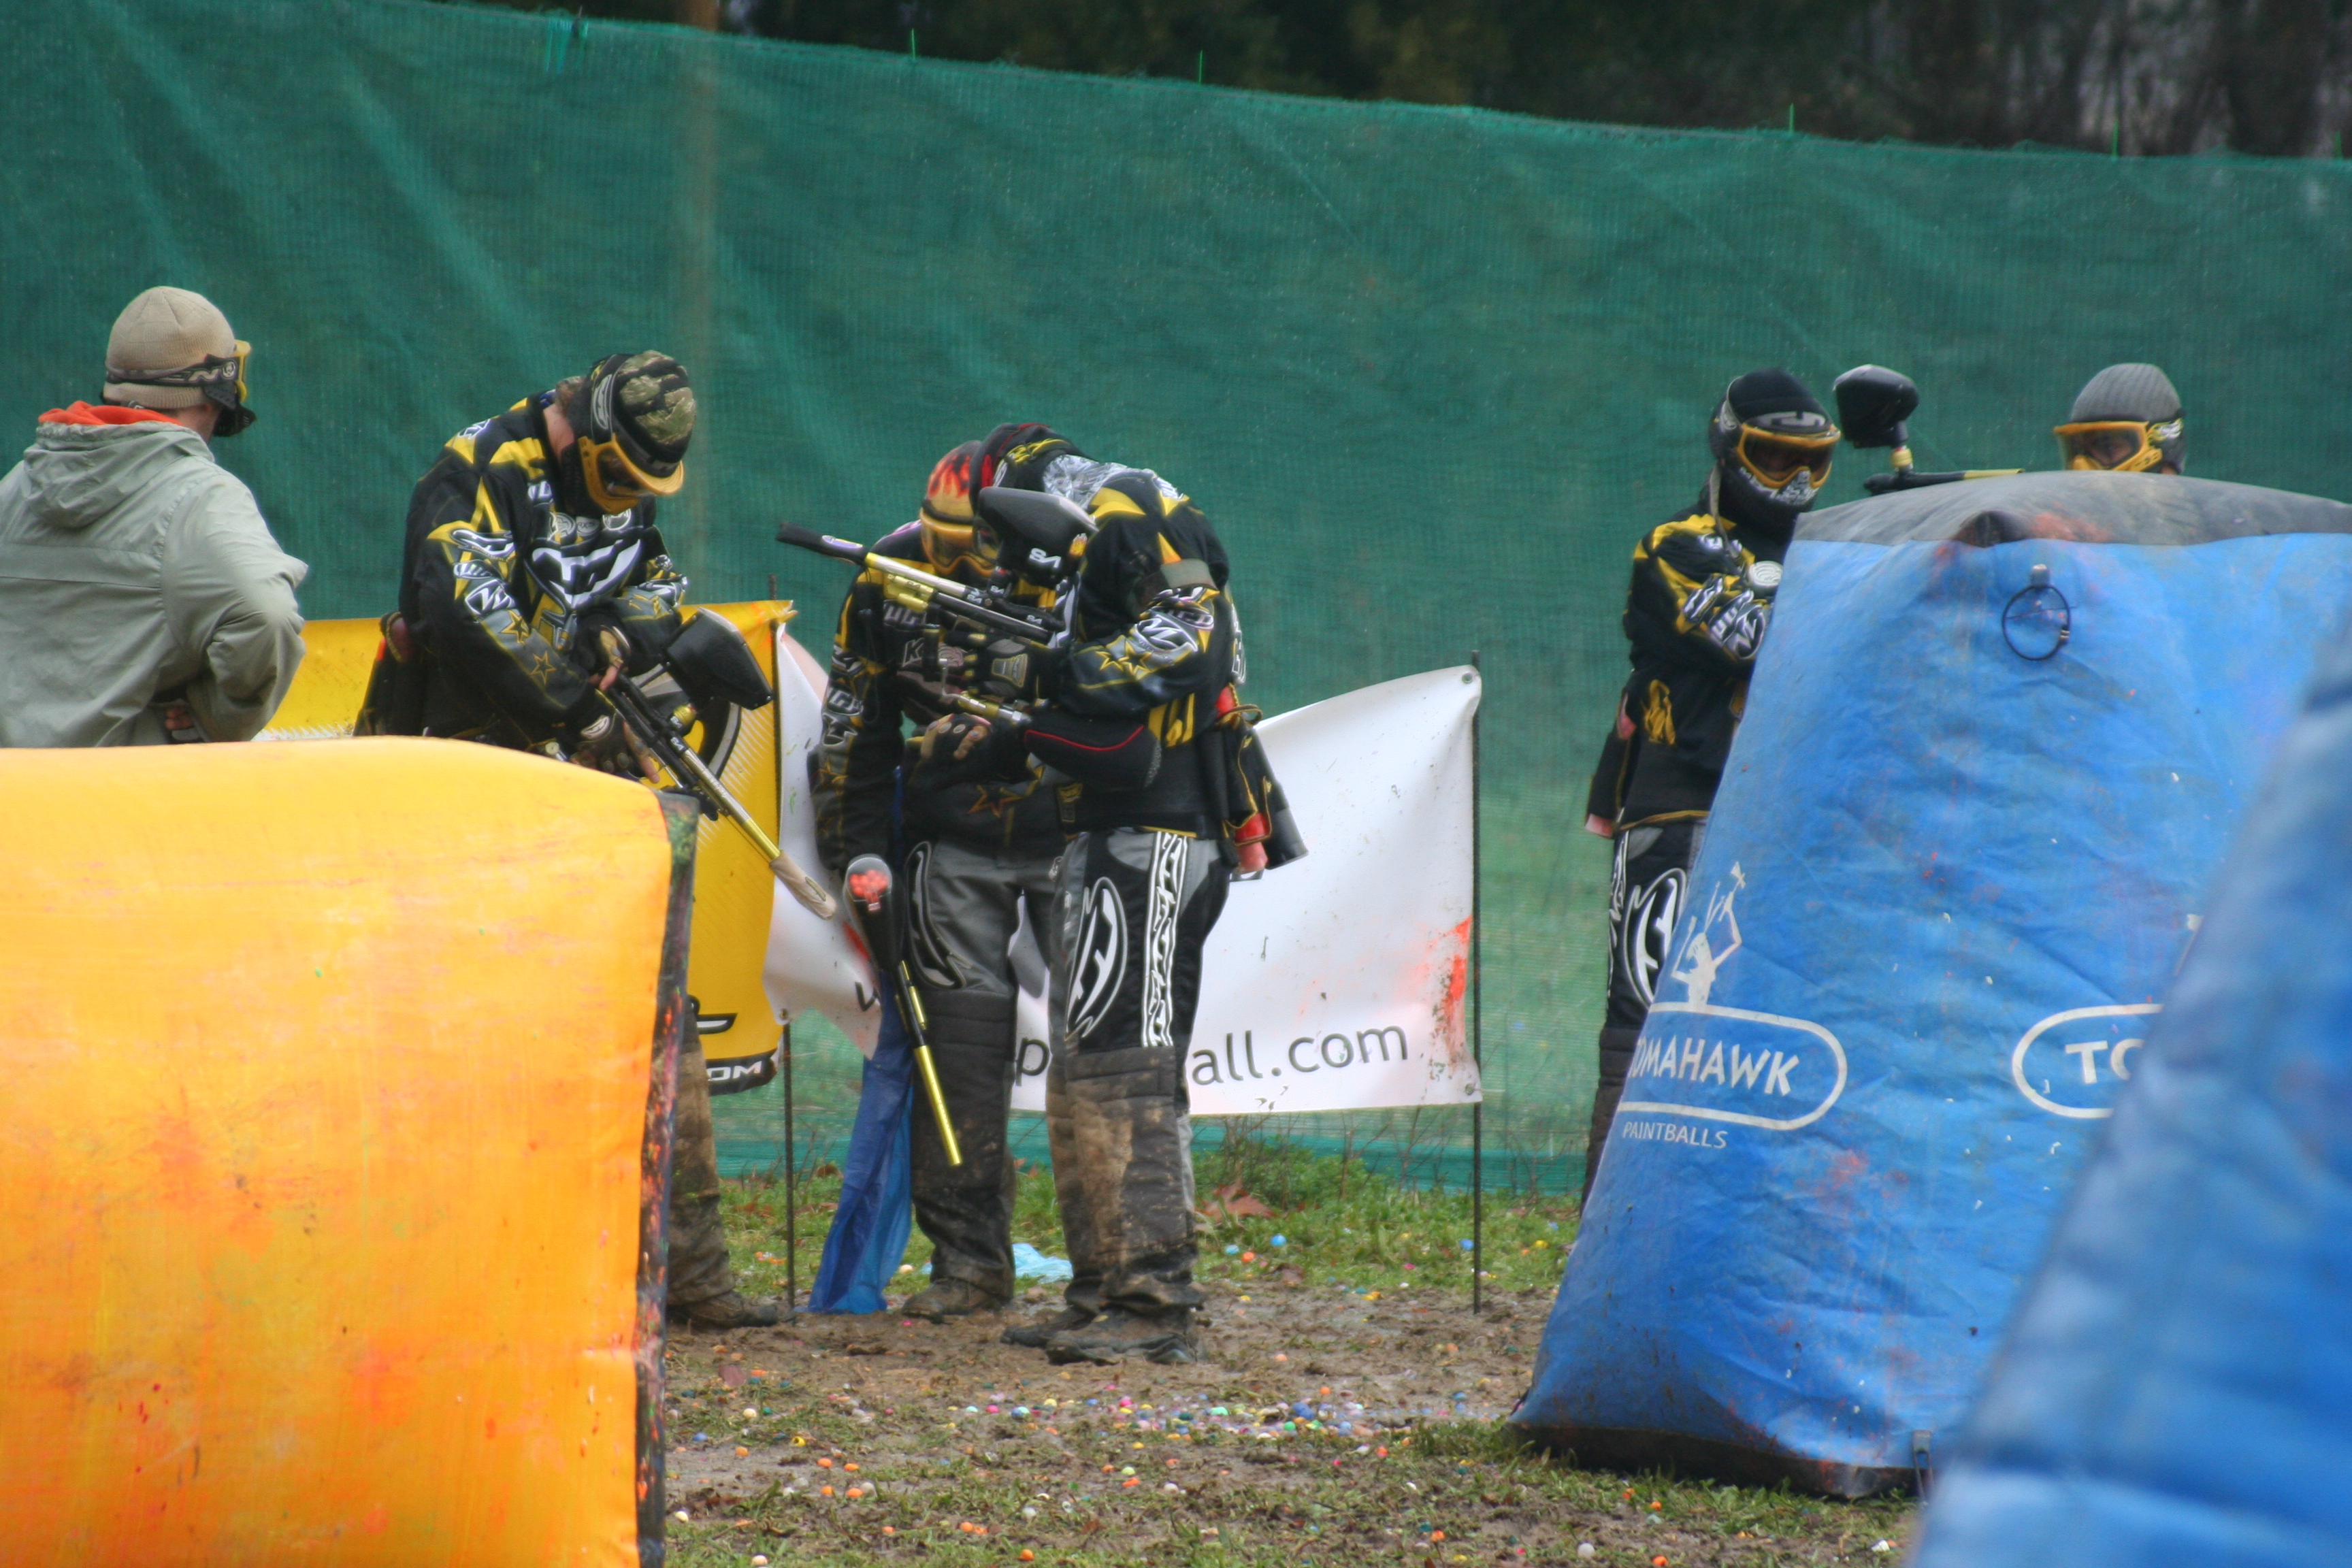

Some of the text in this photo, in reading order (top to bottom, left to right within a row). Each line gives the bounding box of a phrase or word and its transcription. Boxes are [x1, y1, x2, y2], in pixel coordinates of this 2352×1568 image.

[706, 1060, 763, 1082] OM
[1628, 1034, 1801, 1097] OMAHAWK
[1622, 1121, 1729, 1149] PAINTBALLS
